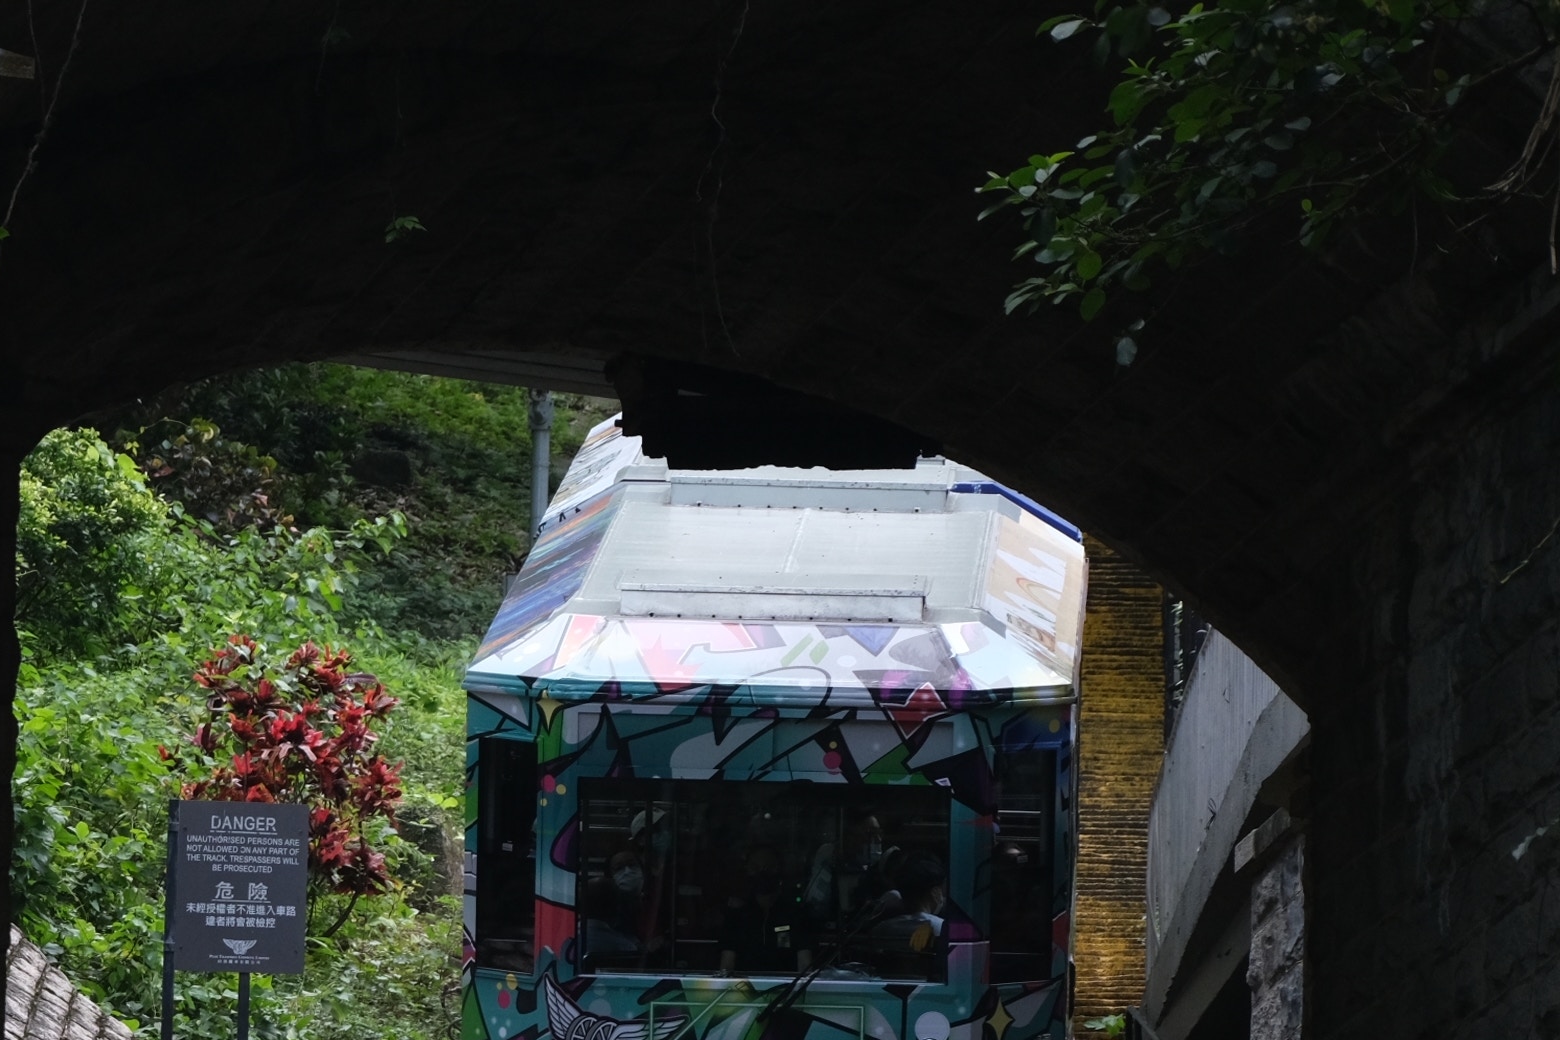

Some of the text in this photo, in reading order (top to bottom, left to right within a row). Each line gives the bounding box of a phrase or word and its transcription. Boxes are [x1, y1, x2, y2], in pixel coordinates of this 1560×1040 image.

[211, 815, 276, 831] DANGER
[186, 835, 300, 847] UNAUTHORISED PERSONS ARE
[186, 844, 300, 856] NOT ALLOWED ON ANY PART OF
[186, 853, 200, 861] THE
[230, 855, 281, 864] TRESPASSERS
[282, 857, 299, 865] WILL
[223, 864, 273, 873] PROSECUTED
[215, 881, 269, 900] 危險
